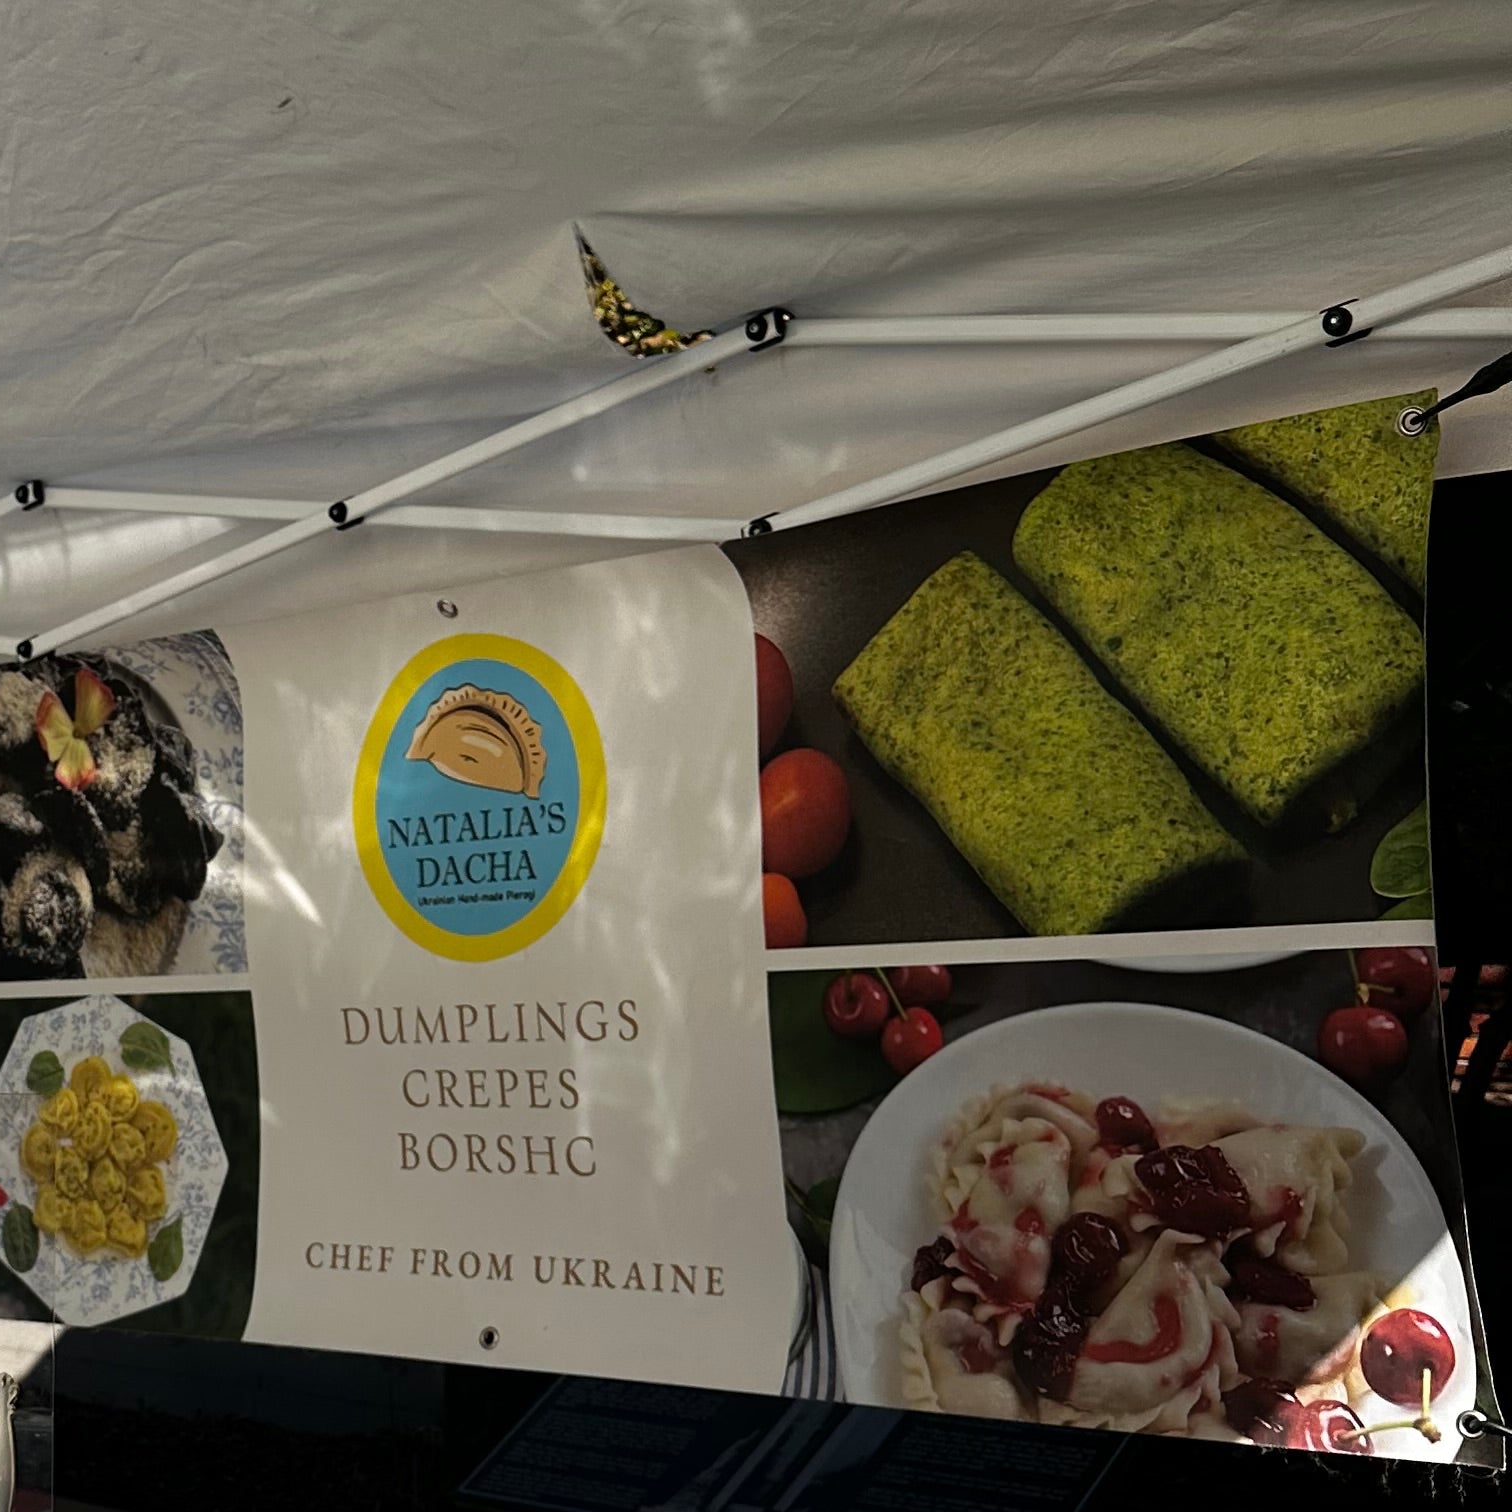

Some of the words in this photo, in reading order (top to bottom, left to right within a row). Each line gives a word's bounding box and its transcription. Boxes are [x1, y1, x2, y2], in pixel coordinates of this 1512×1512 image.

[388, 802, 566, 848] NATALIA'S
[416, 850, 537, 888] DACHA
[341, 1000, 640, 1046] DUMPLINGS
[402, 1067, 581, 1109] CREPES
[398, 1132, 598, 1176] BORSHC
[305, 1242, 394, 1274] CHEF
[411, 1248, 514, 1281] FROM
[533, 1256, 726, 1297] UKRAINE
